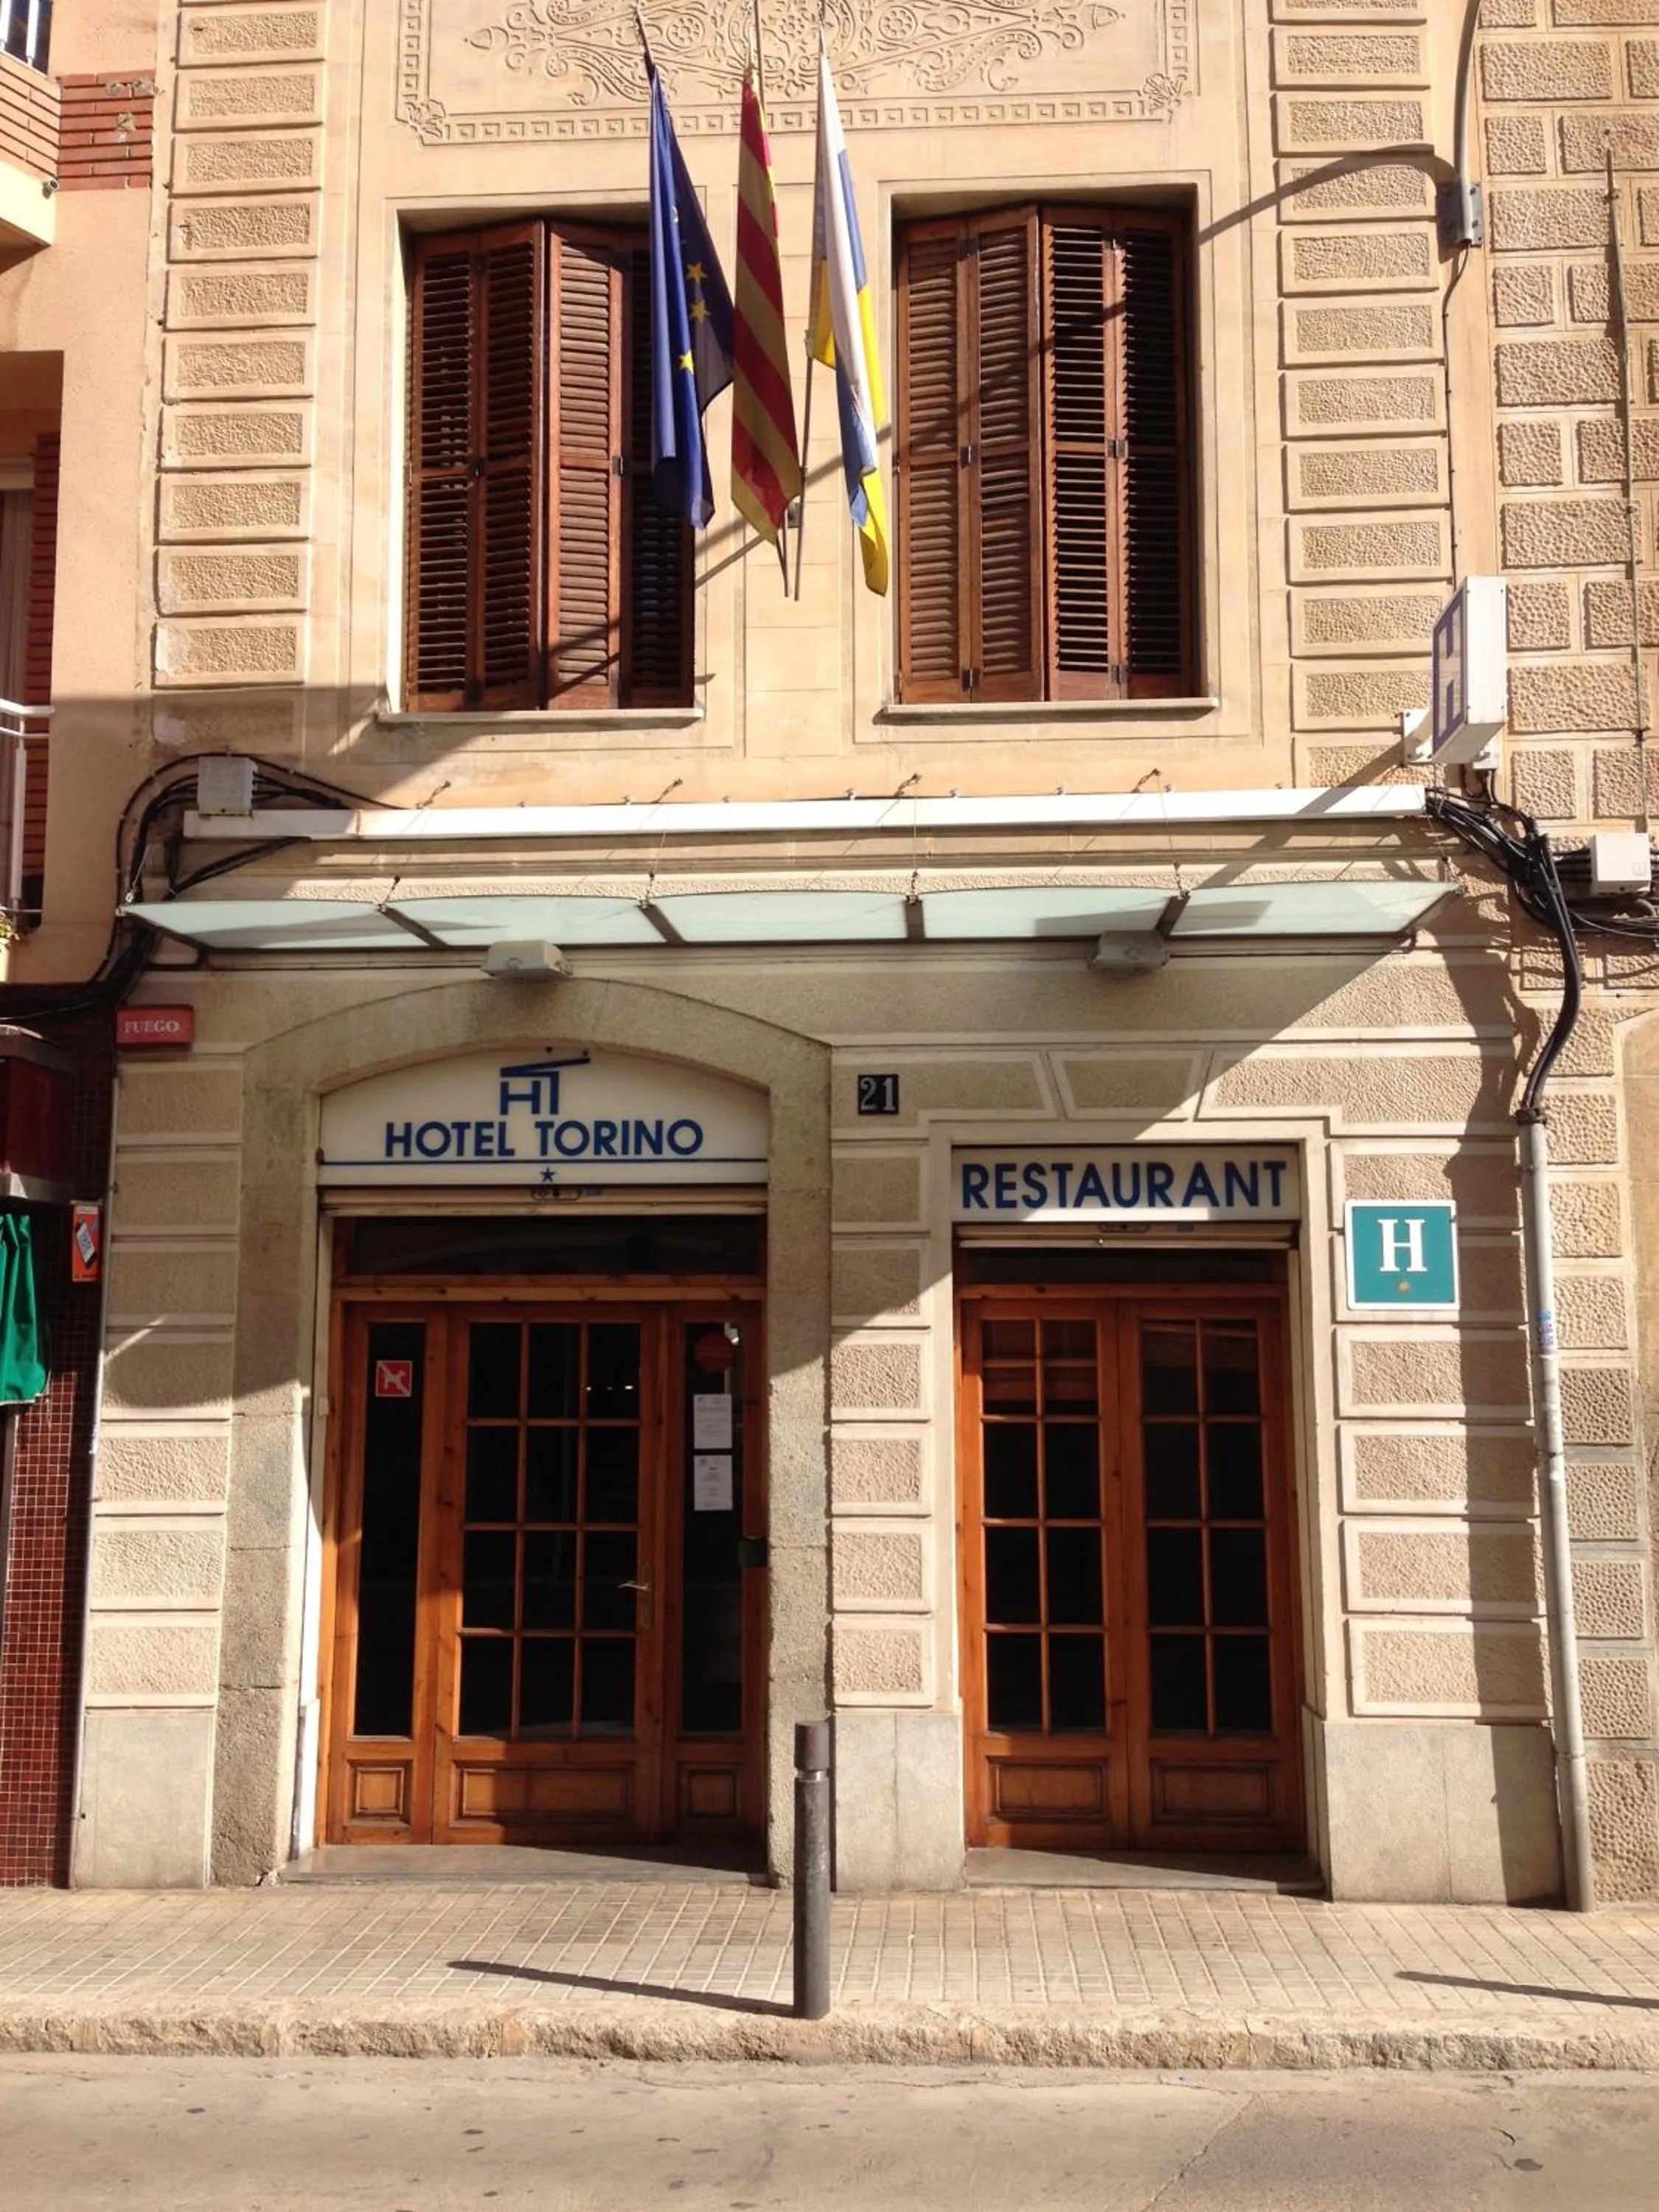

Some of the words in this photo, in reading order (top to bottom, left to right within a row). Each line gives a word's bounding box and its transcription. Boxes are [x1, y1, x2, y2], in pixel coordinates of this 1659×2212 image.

[124, 1020, 180, 1033] FUEGO
[860, 1077, 896, 1111] 21
[385, 1121, 515, 1158] HOTEL
[535, 1119, 703, 1156] TORINO
[962, 1161, 1287, 1209] RESTAURANT
[1377, 1219, 1428, 1272] H
